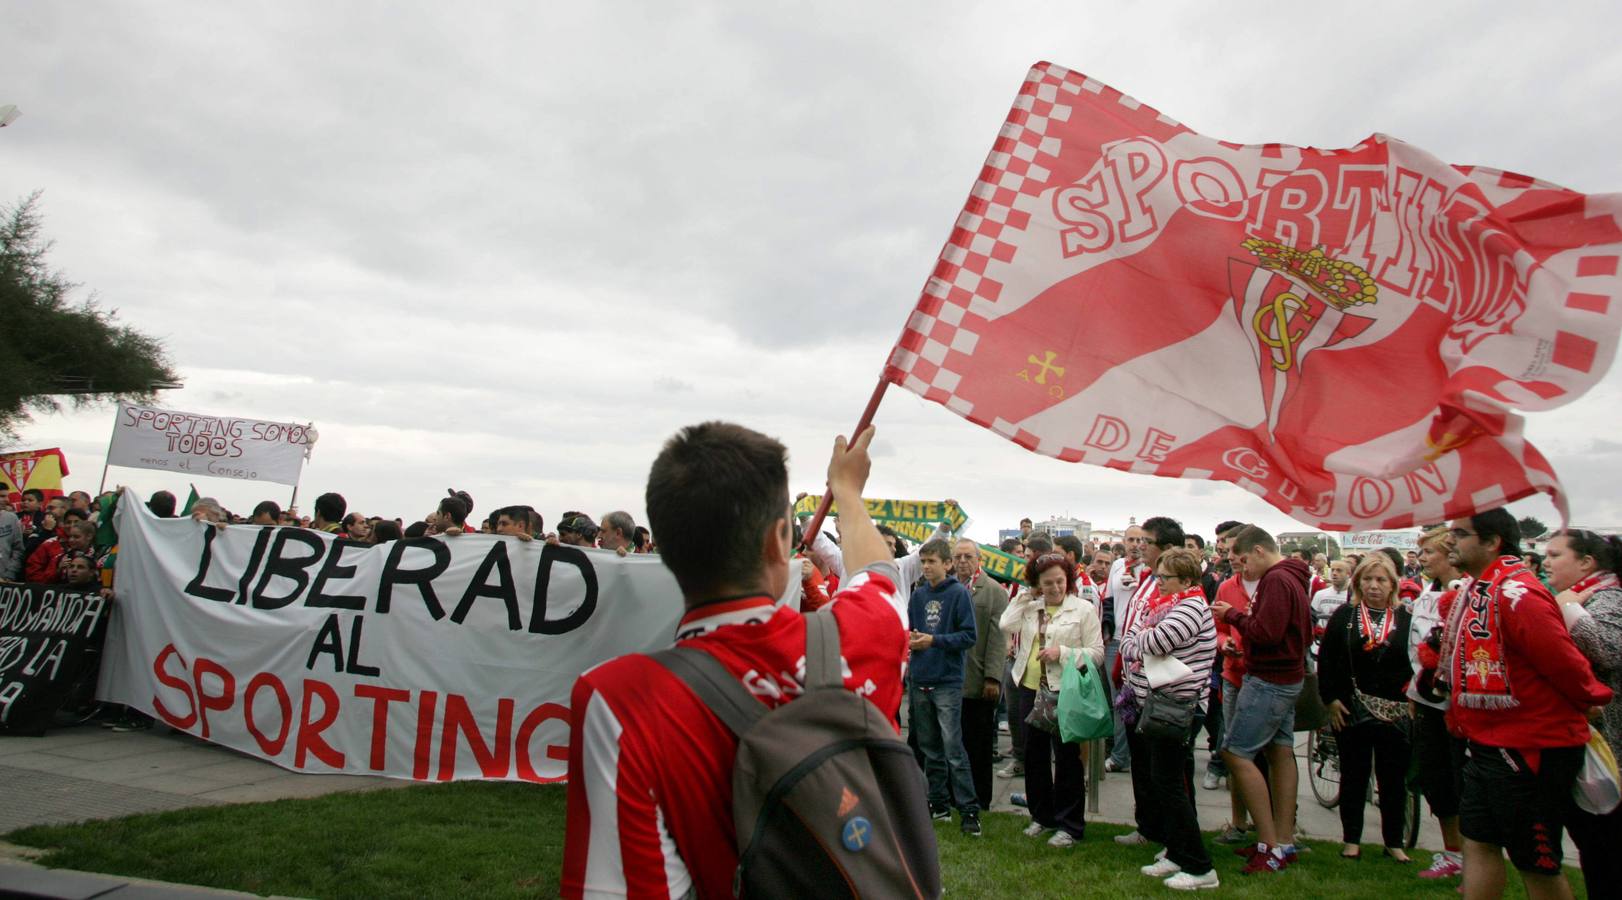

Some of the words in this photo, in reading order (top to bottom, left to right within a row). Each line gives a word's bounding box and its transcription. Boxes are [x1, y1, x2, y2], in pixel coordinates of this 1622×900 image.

[1052, 135, 1528, 342] SPORTING
[123, 407, 246, 438] SPORTING
[251, 422, 312, 445] SOMOS
[1084, 414, 1177, 462] DE
[140, 457, 169, 467] menos
[178, 460, 191, 471] el
[207, 460, 258, 480] Consejo
[891, 500, 939, 519] VETE
[184, 523, 599, 635] LIBERAD
[22, 637, 67, 680] LA
[306, 613, 381, 677] AL
[152, 643, 572, 784] SPORTING
